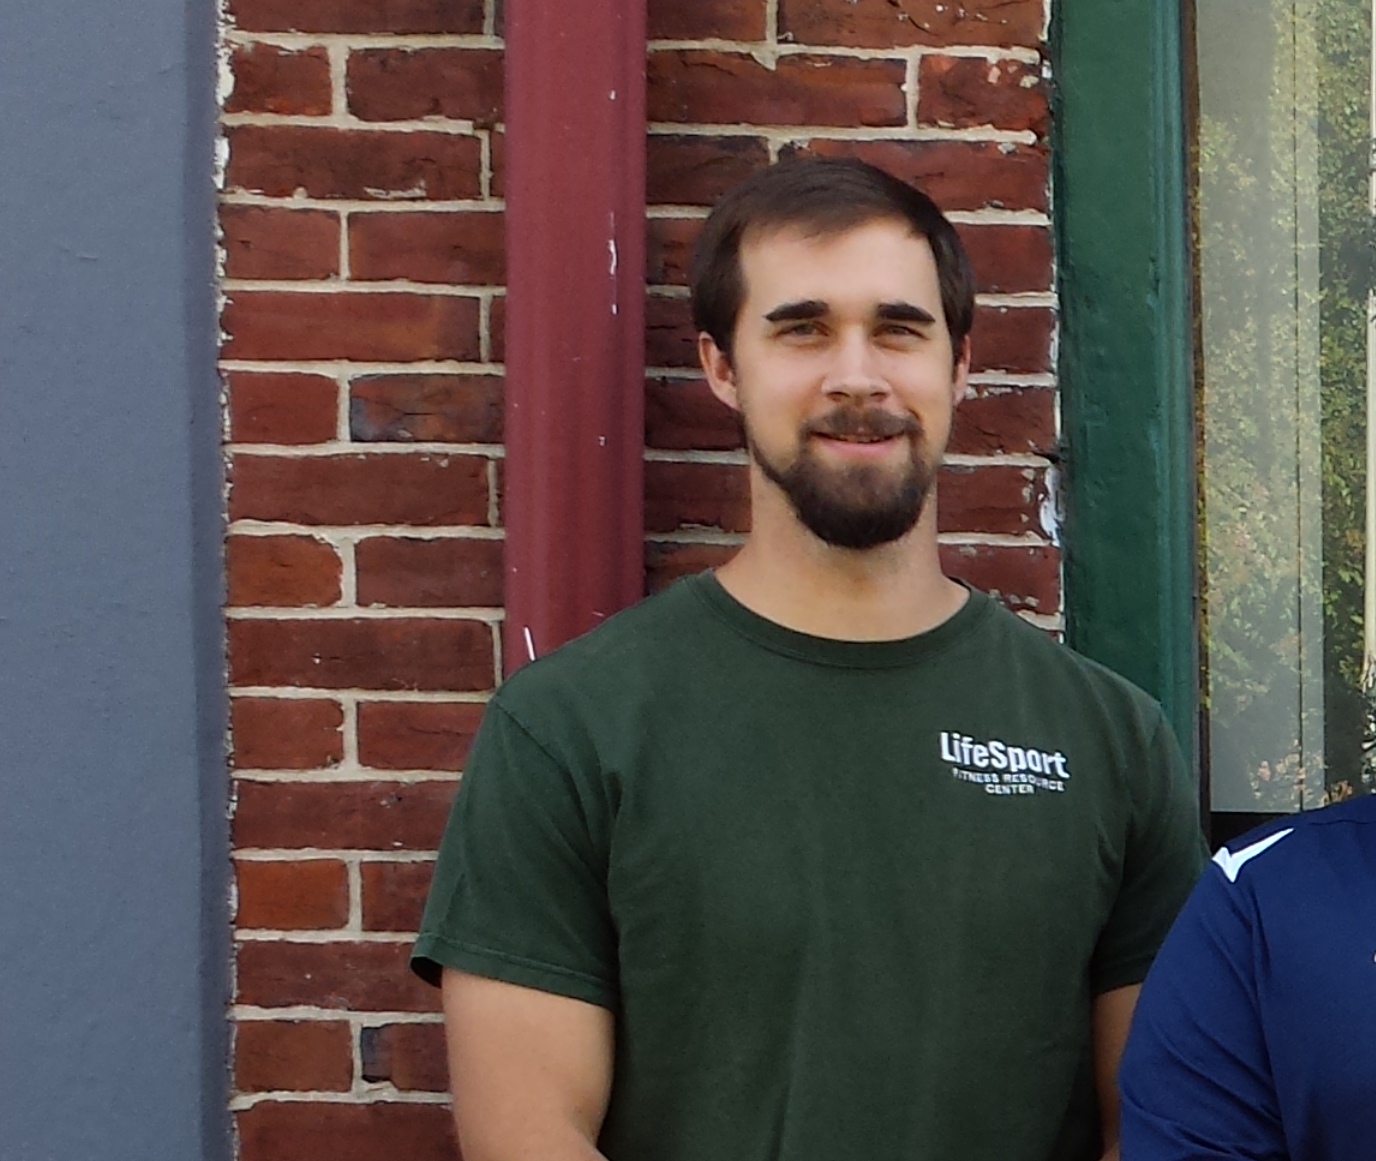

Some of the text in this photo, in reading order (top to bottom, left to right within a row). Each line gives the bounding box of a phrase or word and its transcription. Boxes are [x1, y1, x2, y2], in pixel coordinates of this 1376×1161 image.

[940, 731, 1071, 779] LifeSport
[952, 767, 1065, 792] FITNESS RESOURCE
[985, 784, 1034, 795] CENTER
